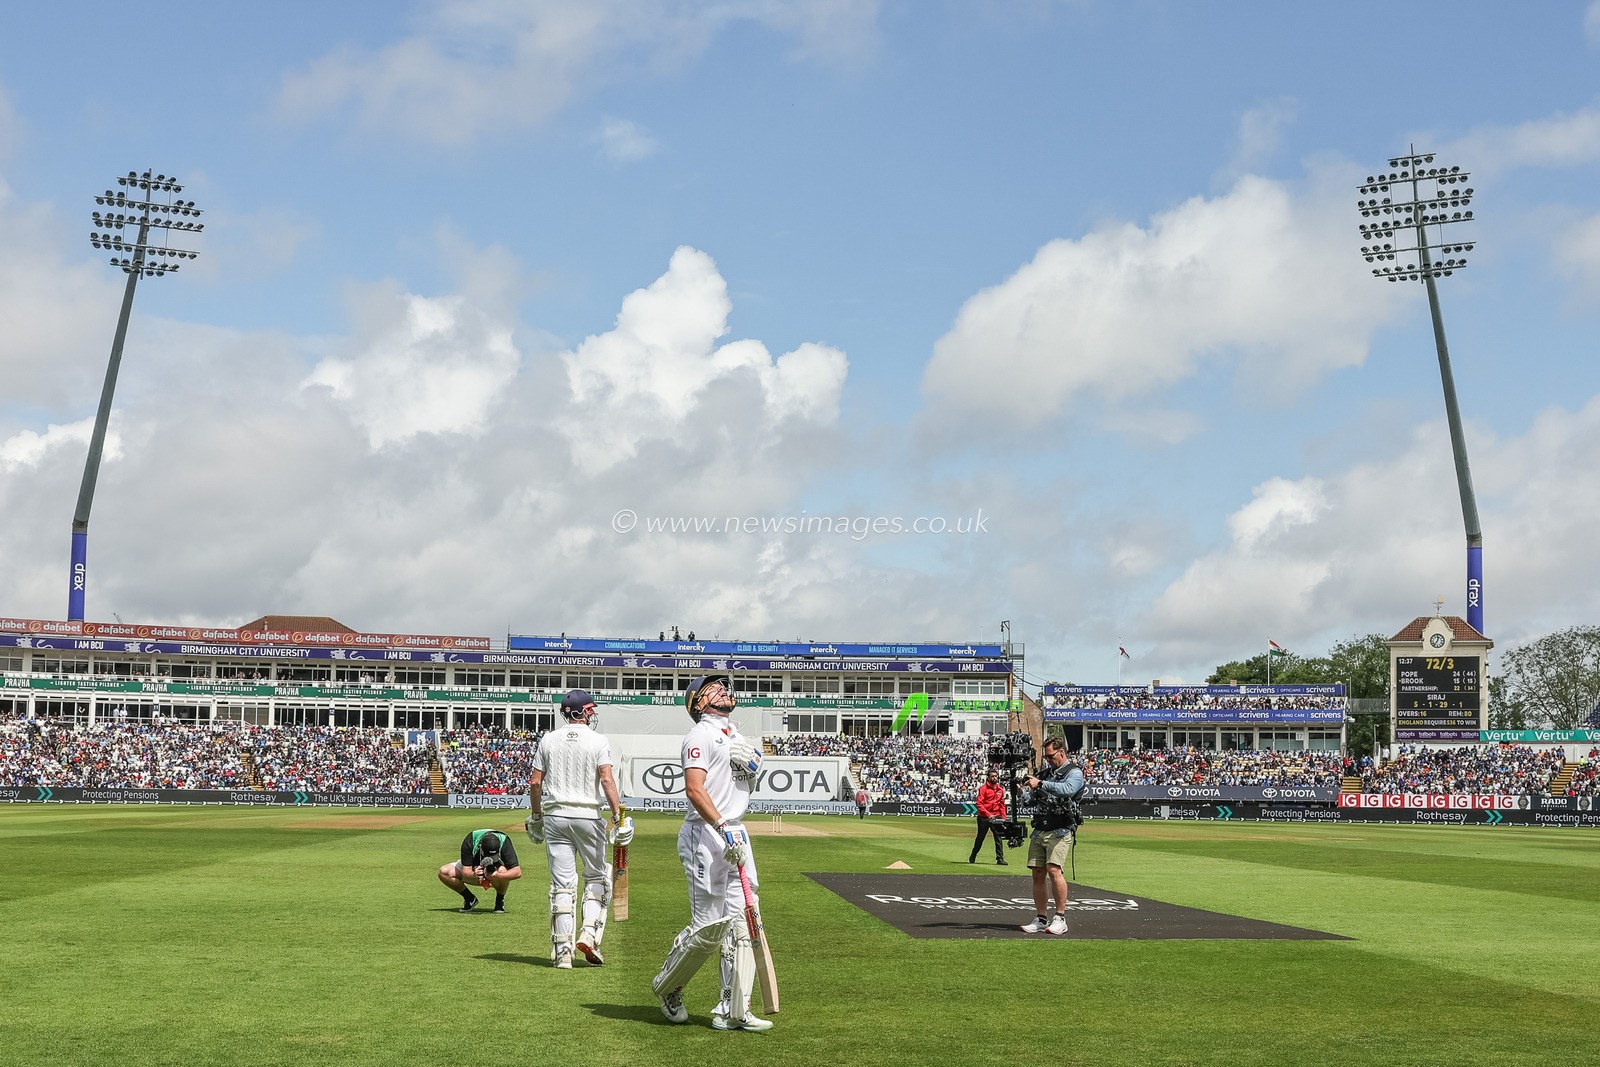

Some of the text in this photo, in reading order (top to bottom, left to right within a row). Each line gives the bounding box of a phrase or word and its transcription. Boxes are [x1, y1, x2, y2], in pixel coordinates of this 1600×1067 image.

[73, 563, 85, 591] drax
[1468, 578, 1481, 608] drax
[0, 619, 26, 630] fabet
[43, 622, 81, 632] dafabet
[98, 624, 134, 635] dafabet
[151, 626, 187, 638] dafabet
[203, 630, 238, 640] dafabet
[254, 632, 289, 642] dafabet
[305, 634, 340, 645] dafabet
[356, 636, 390, 646] dafabet
[405, 638, 440, 647] dafabet
[454, 639, 489, 648] dafabet
[78, 641, 90, 649] AM
[92, 641, 104, 650] BCU
[181, 645, 310, 657] BIRMINGHAM CITY UNIVERSITY
[758, 645, 778, 653] SECURITY
[483, 655, 605, 666] BIRMINGHAM CITY UNIVERSITY
[689, 660, 701, 668] BCU
[1426, 658, 1454, 670] 72/3
[770, 662, 822, 670] BIRMINGHAM
[842, 663, 889, 671] UNIVERSITY
[5, 678, 30, 687] PRAVHA
[142, 683, 168, 692] PRAVHA
[275, 687, 299, 696] PRAVHA
[404, 691, 428, 699] PRAVHA
[1485, 731, 1519, 740] Vertu
[1535, 731, 1569, 740] Vertu
[688, 748, 700, 759] IG
[755, 770, 830, 792] YOTA
[82, 790, 158, 800] Protecting Pensions
[230, 792, 276, 803] Rothesay
[314, 794, 328, 802] The
[330, 794, 347, 803] UK's
[349, 794, 373, 805] largest
[374, 796, 405, 805] pension
[406, 796, 432, 804] insurer
[456, 795, 523, 806] Rothesay
[644, 798, 688, 808] Rothes
[831, 803, 860, 811] insure
[1342, 795, 1357, 807] IG
[1364, 795, 1378, 807] IG
[1386, 795, 1401, 807] IG
[1409, 796, 1423, 808] IG
[1431, 796, 1446, 808] IG
[1453, 796, 1468, 808] IG
[1475, 796, 1490, 808] IG
[1498, 796, 1512, 808] IG
[900, 804, 946, 814] Rothesay
[1262, 809, 1302, 819] Protecting
[1304, 810, 1340, 818] Pensions
[1416, 812, 1467, 823] Rothesay
[1535, 813, 1580, 823] Protecting
[866, 894, 1139, 907] Rothesay
